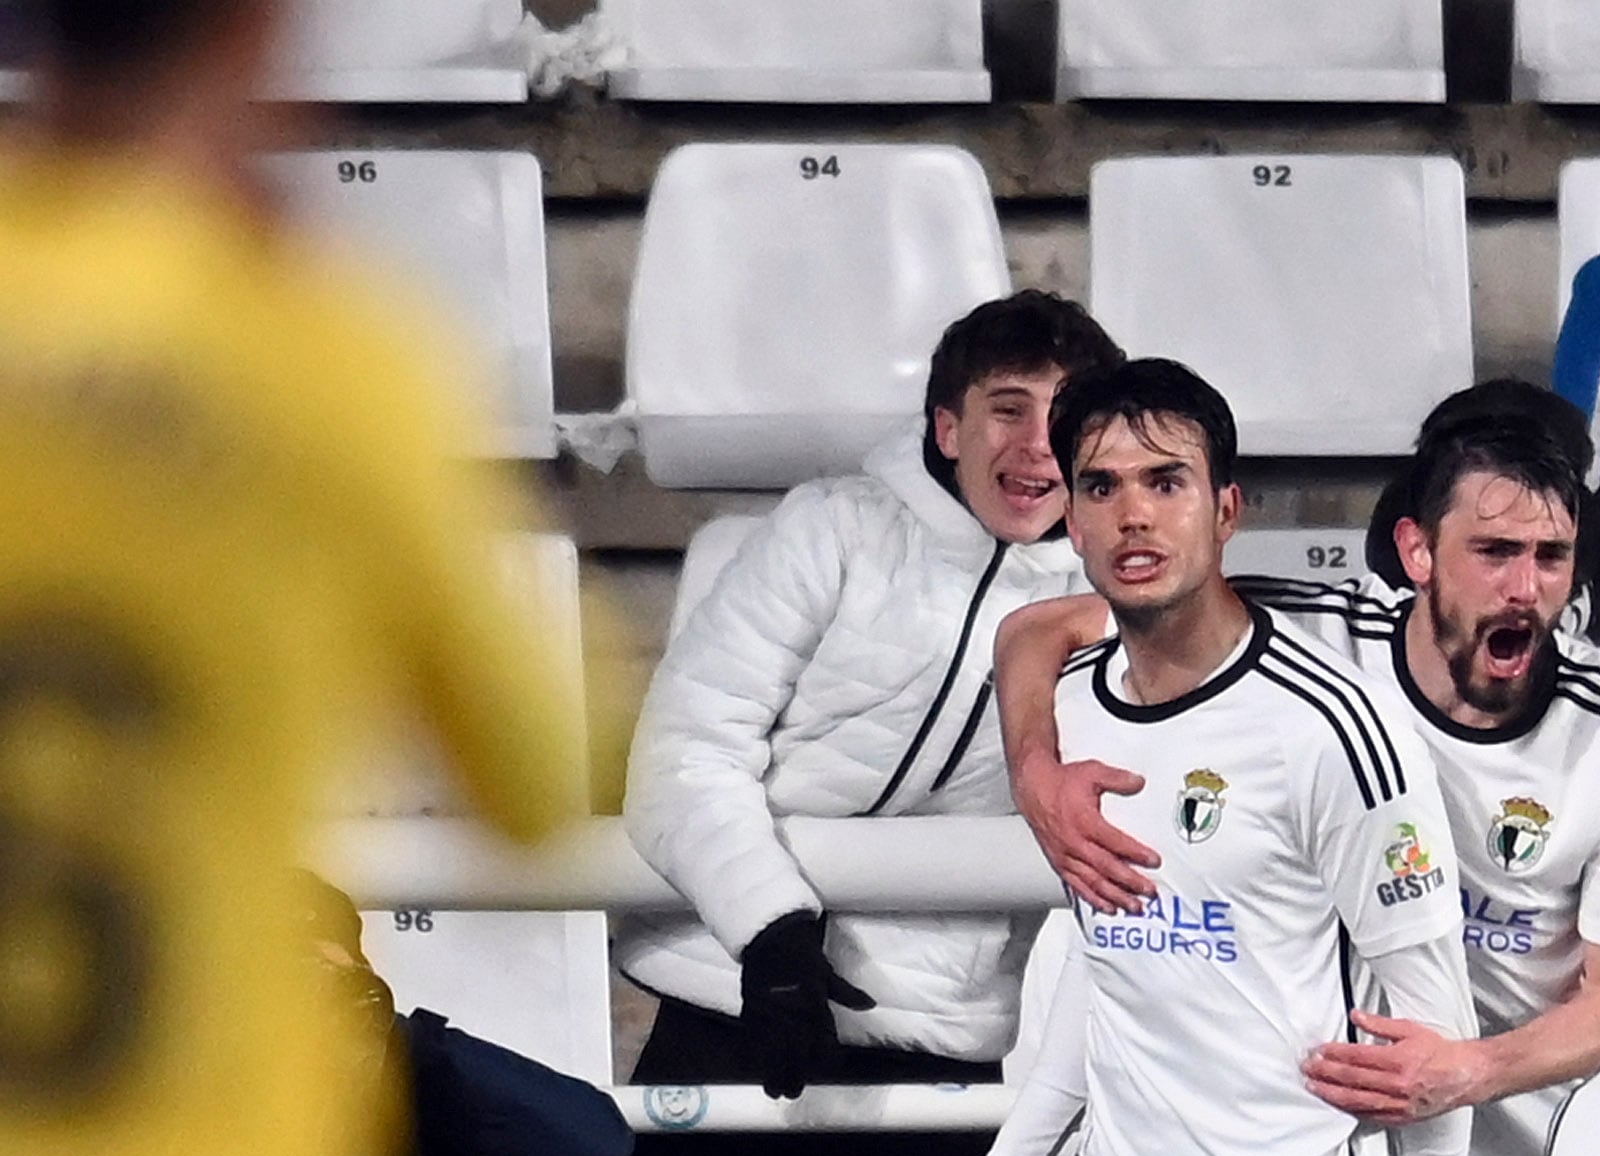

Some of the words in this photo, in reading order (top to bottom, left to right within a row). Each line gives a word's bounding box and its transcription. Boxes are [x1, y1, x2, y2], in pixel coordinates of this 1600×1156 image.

[338, 160, 377, 183] 96
[800, 155, 841, 180] 94
[1253, 165, 1292, 187] 92
[1307, 546, 1347, 568] 92
[394, 909, 433, 932] 96
[1092, 892, 1235, 933] ALE
[1094, 926, 1238, 963] SEGUROS
[1462, 924, 1533, 955] ROS
